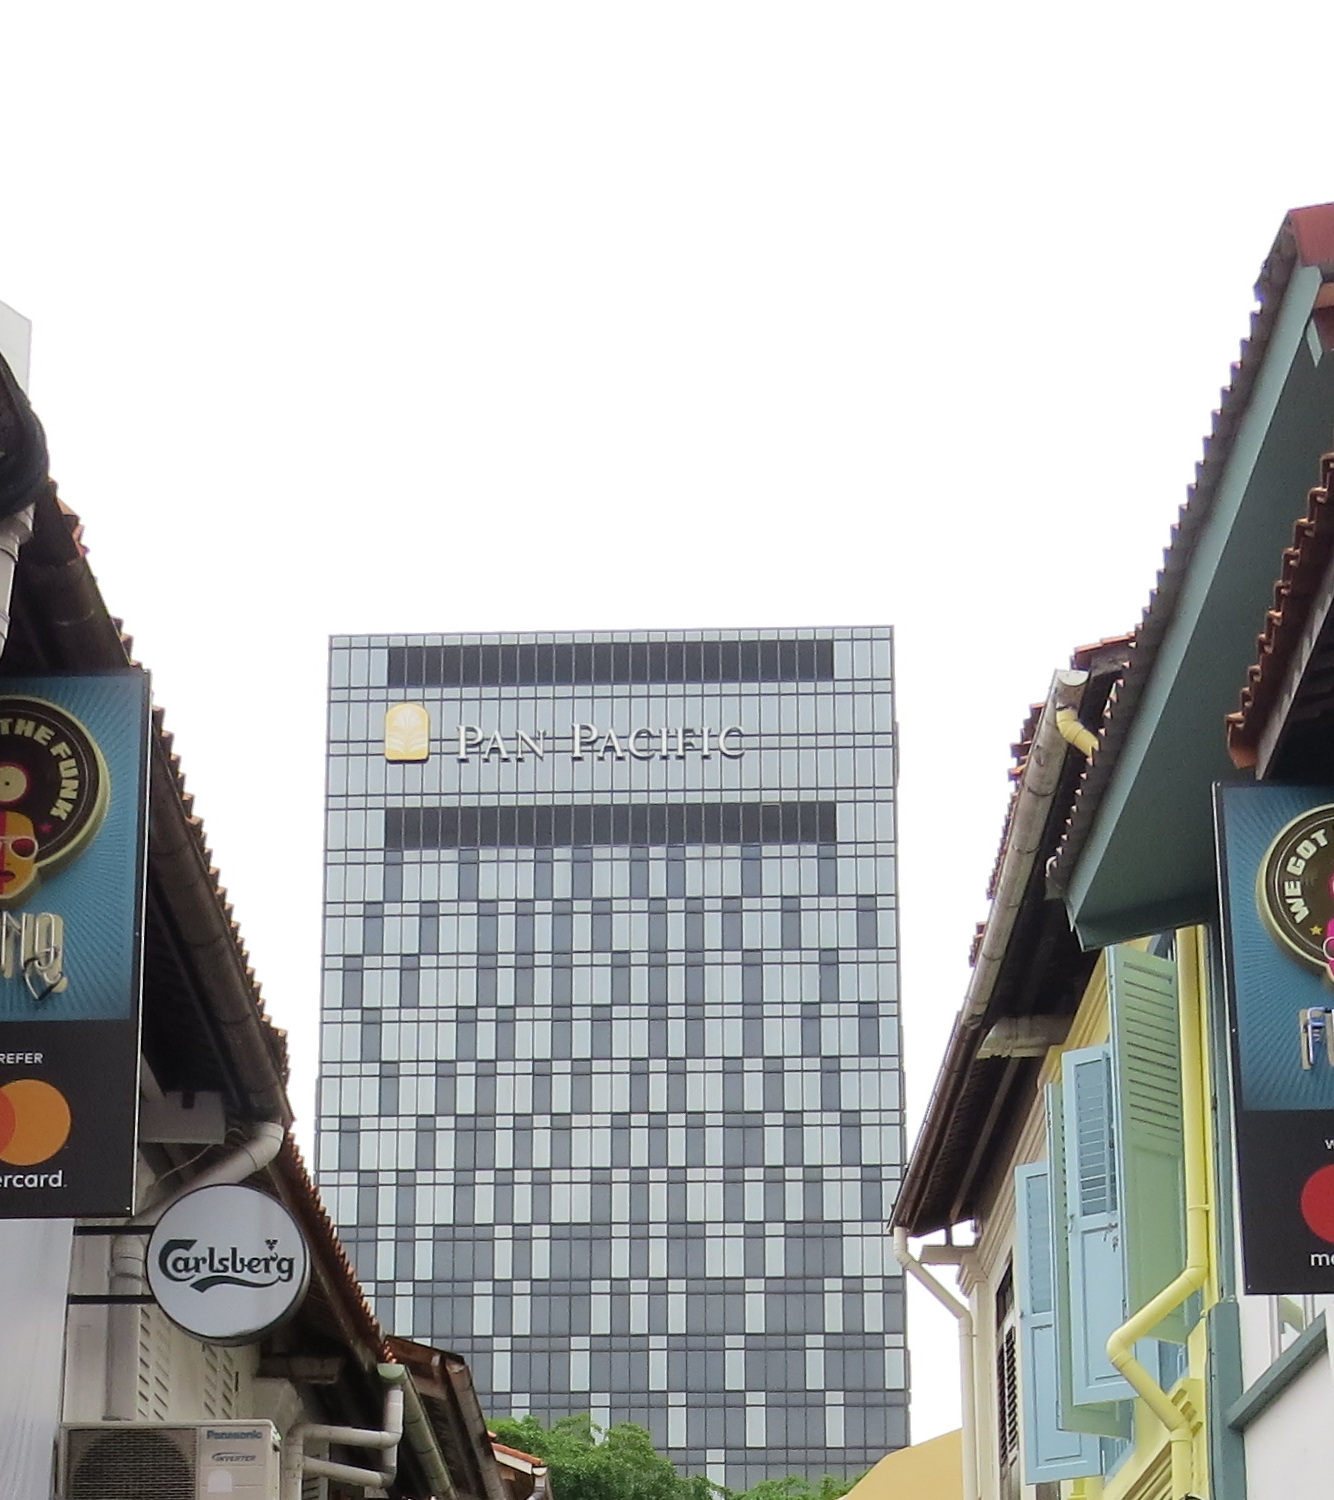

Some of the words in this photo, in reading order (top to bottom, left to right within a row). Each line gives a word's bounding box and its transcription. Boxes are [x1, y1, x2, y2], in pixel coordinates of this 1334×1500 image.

[456, 725, 546, 763] PAN
[570, 722, 747, 761] PACIFIC
[49, 742, 77, 824] FUNK
[1288, 834, 1329, 876] GOT
[1283, 880, 1309, 925] WE
[158, 1237, 294, 1293] Carlsberg
[207, 1430, 262, 1440] Panasonic
